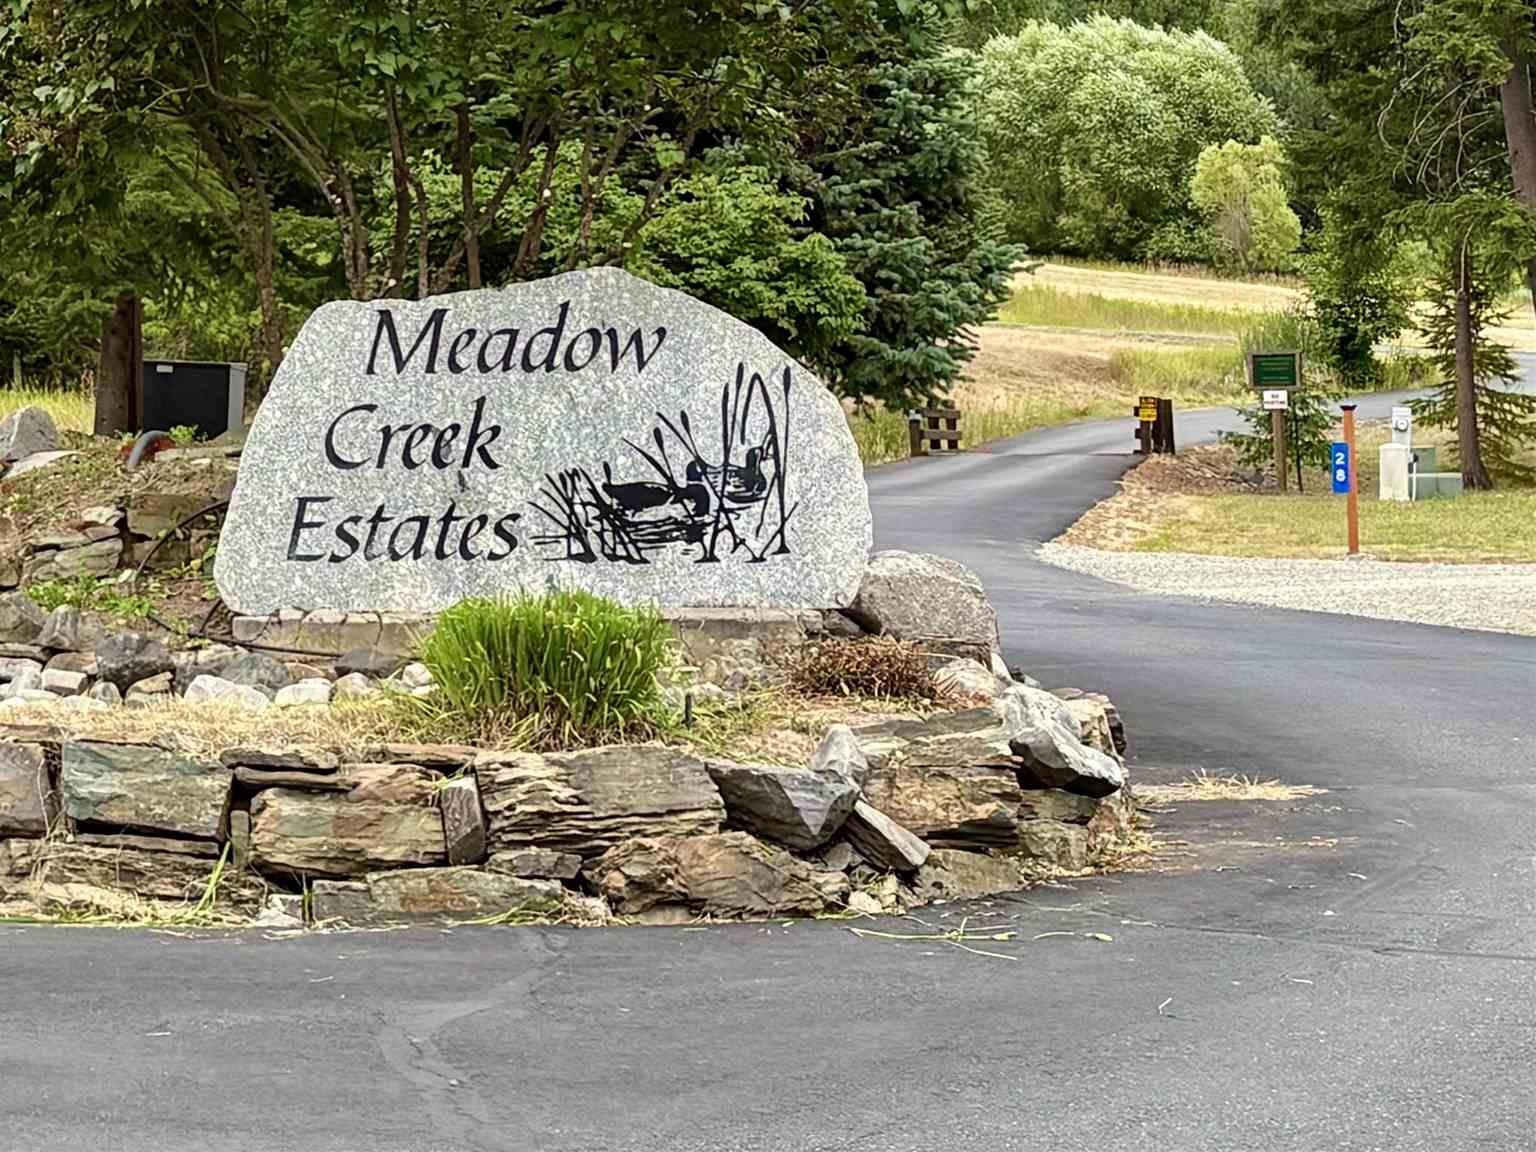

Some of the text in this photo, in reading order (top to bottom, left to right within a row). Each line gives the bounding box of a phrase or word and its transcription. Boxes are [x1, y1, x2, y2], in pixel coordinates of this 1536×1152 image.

[365, 301, 668, 375] Meadow
[324, 395, 503, 471] Creek
[286, 494, 522, 564] Estates
